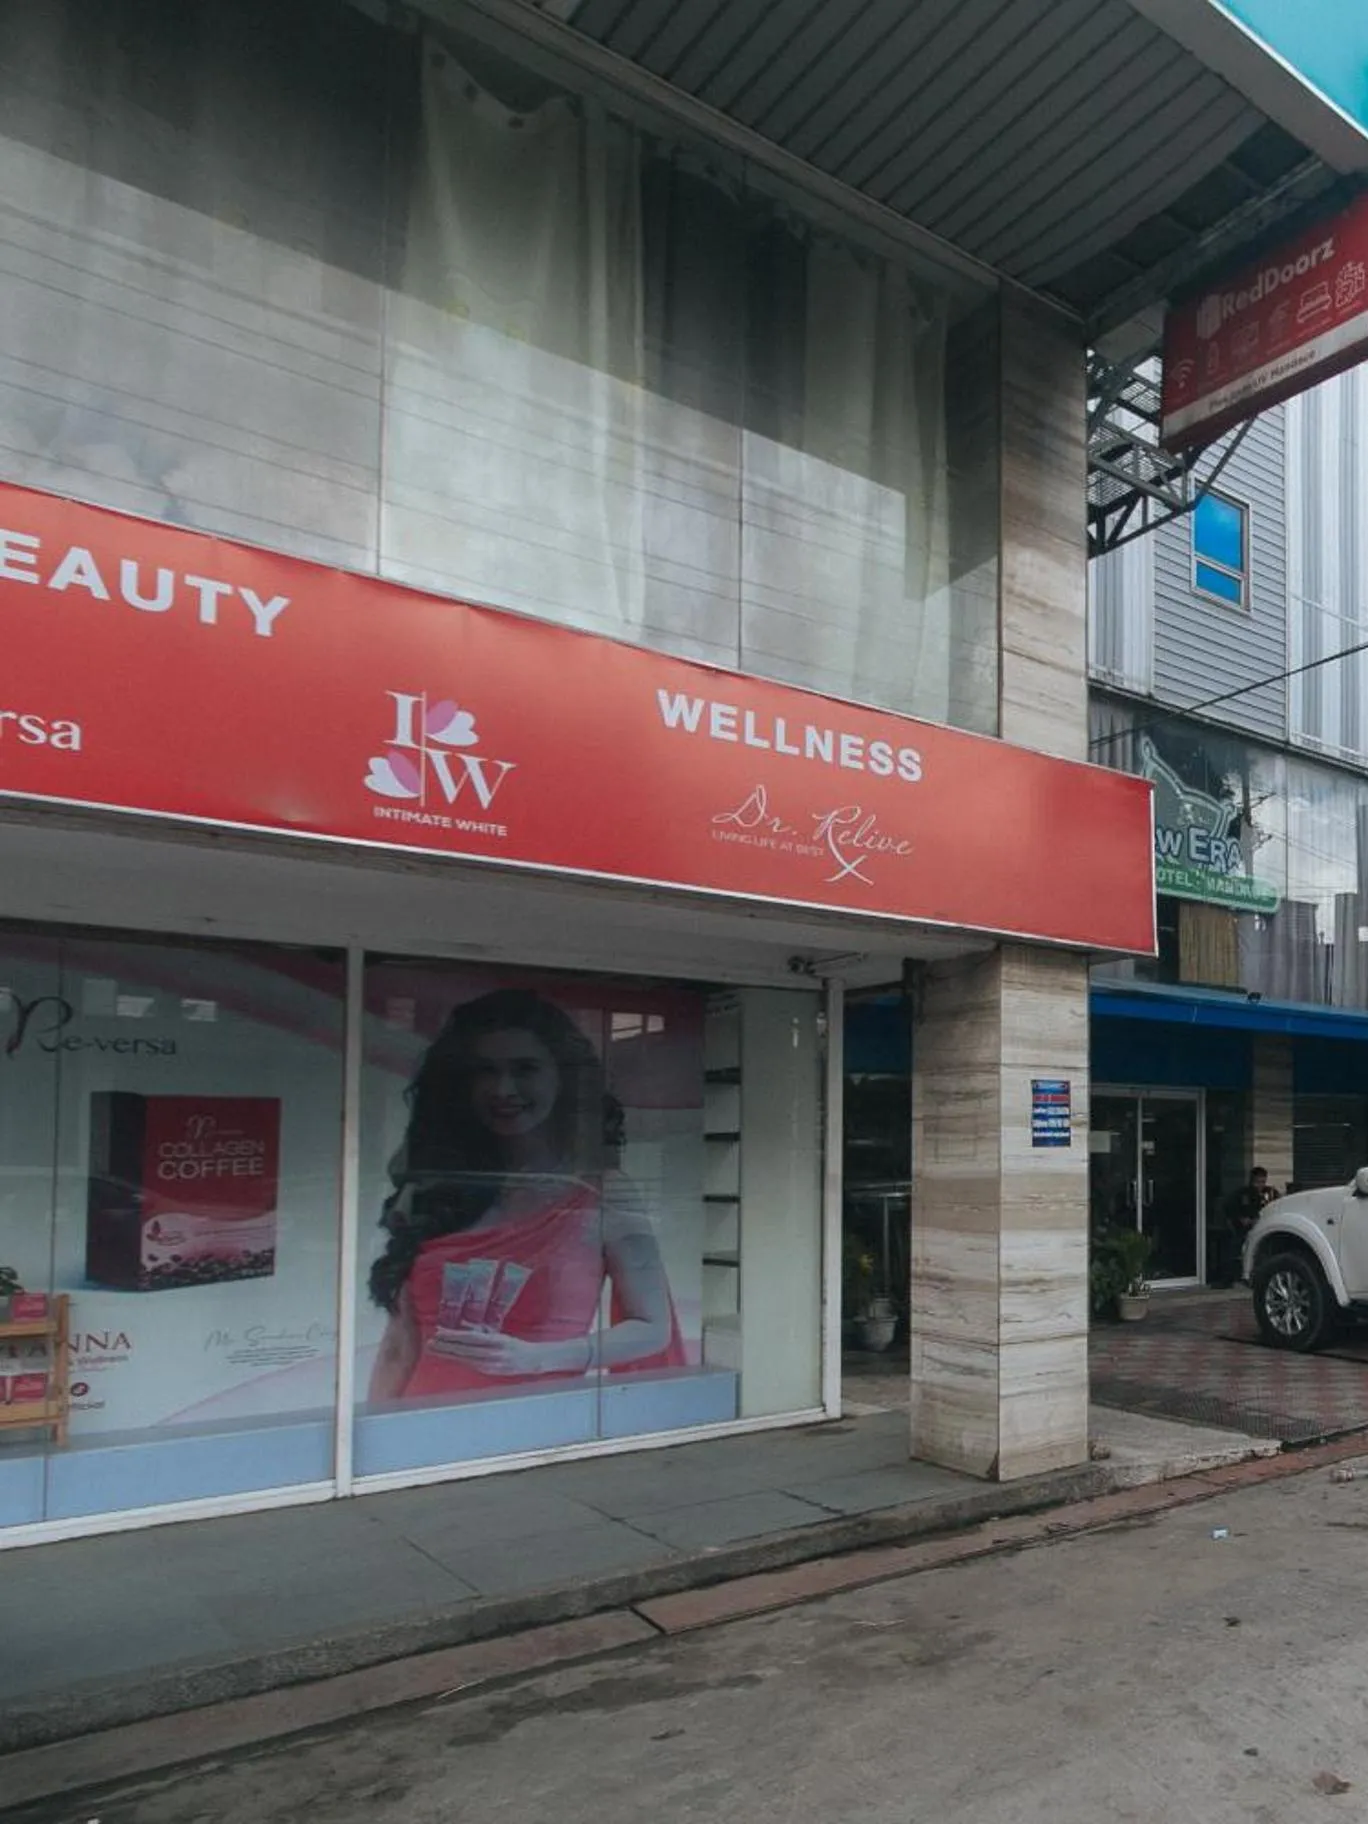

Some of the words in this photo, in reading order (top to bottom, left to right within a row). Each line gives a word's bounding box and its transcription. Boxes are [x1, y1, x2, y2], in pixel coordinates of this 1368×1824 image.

[1220, 237, 1336, 320] RedDoorz
[0, 528, 290, 637] EAUTY
[656, 689, 924, 782] WELLNESS
[373, 805, 452, 828] INTIMATE
[455, 818, 508, 837] WHITE
[712, 784, 798, 835] Dr.
[812, 806, 913, 885] Relive
[780, 841, 793, 852] AT
[1189, 826, 1243, 876] ERA
[1157, 867, 1193, 888] OTEL
[157, 1139, 265, 1160] COLLAGEN
[157, 1157, 264, 1180] COFFEE
